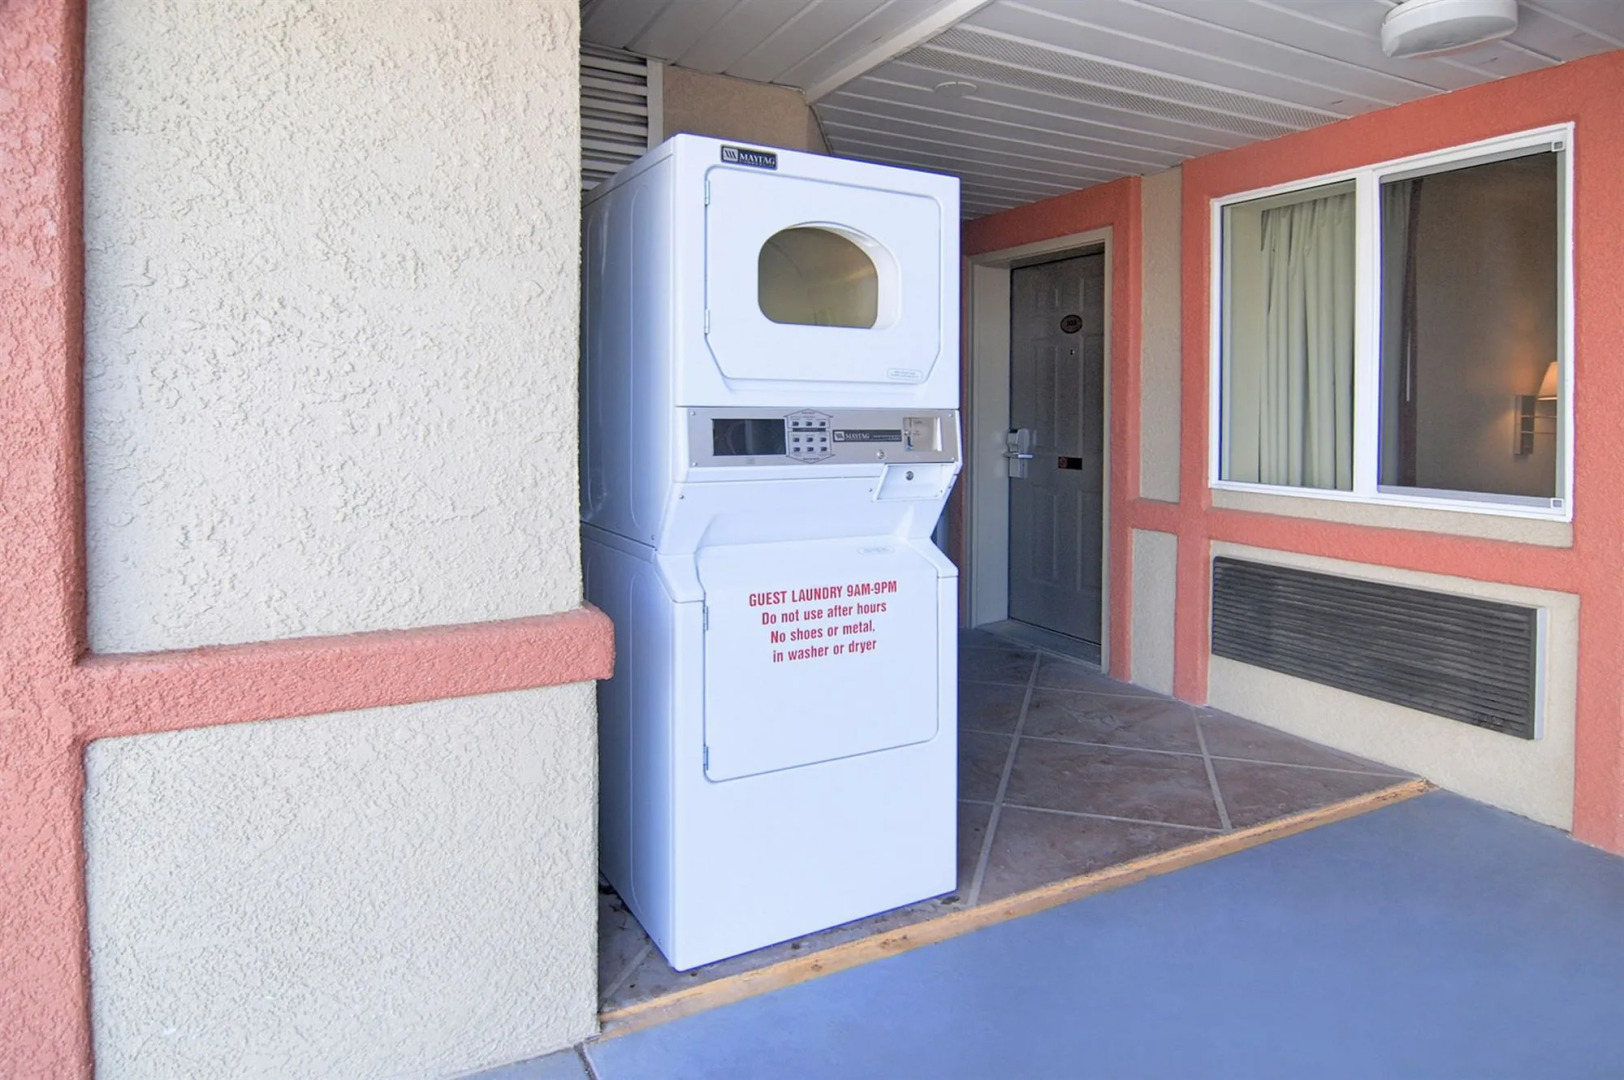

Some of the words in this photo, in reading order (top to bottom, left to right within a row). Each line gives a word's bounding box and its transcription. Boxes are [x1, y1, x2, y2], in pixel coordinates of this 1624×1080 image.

[740, 153, 775, 165] MAYTAG
[749, 590, 787, 607] GUEST
[791, 586, 843, 603] LAUNDRY
[847, 580, 897, 597] 9AM-9PM
[762, 612, 777, 625] Do
[781, 610, 799, 623] not
[804, 609, 824, 621] use
[827, 605, 853, 618] after
[857, 602, 887, 615] hours
[770, 631, 786, 644] No
[790, 628, 823, 642] shoes
[827, 627, 838, 637] or
[773, 650, 783, 663] in
[788, 645, 829, 661] washer
[833, 644, 844, 655] or
[848, 639, 877, 654] dryer
